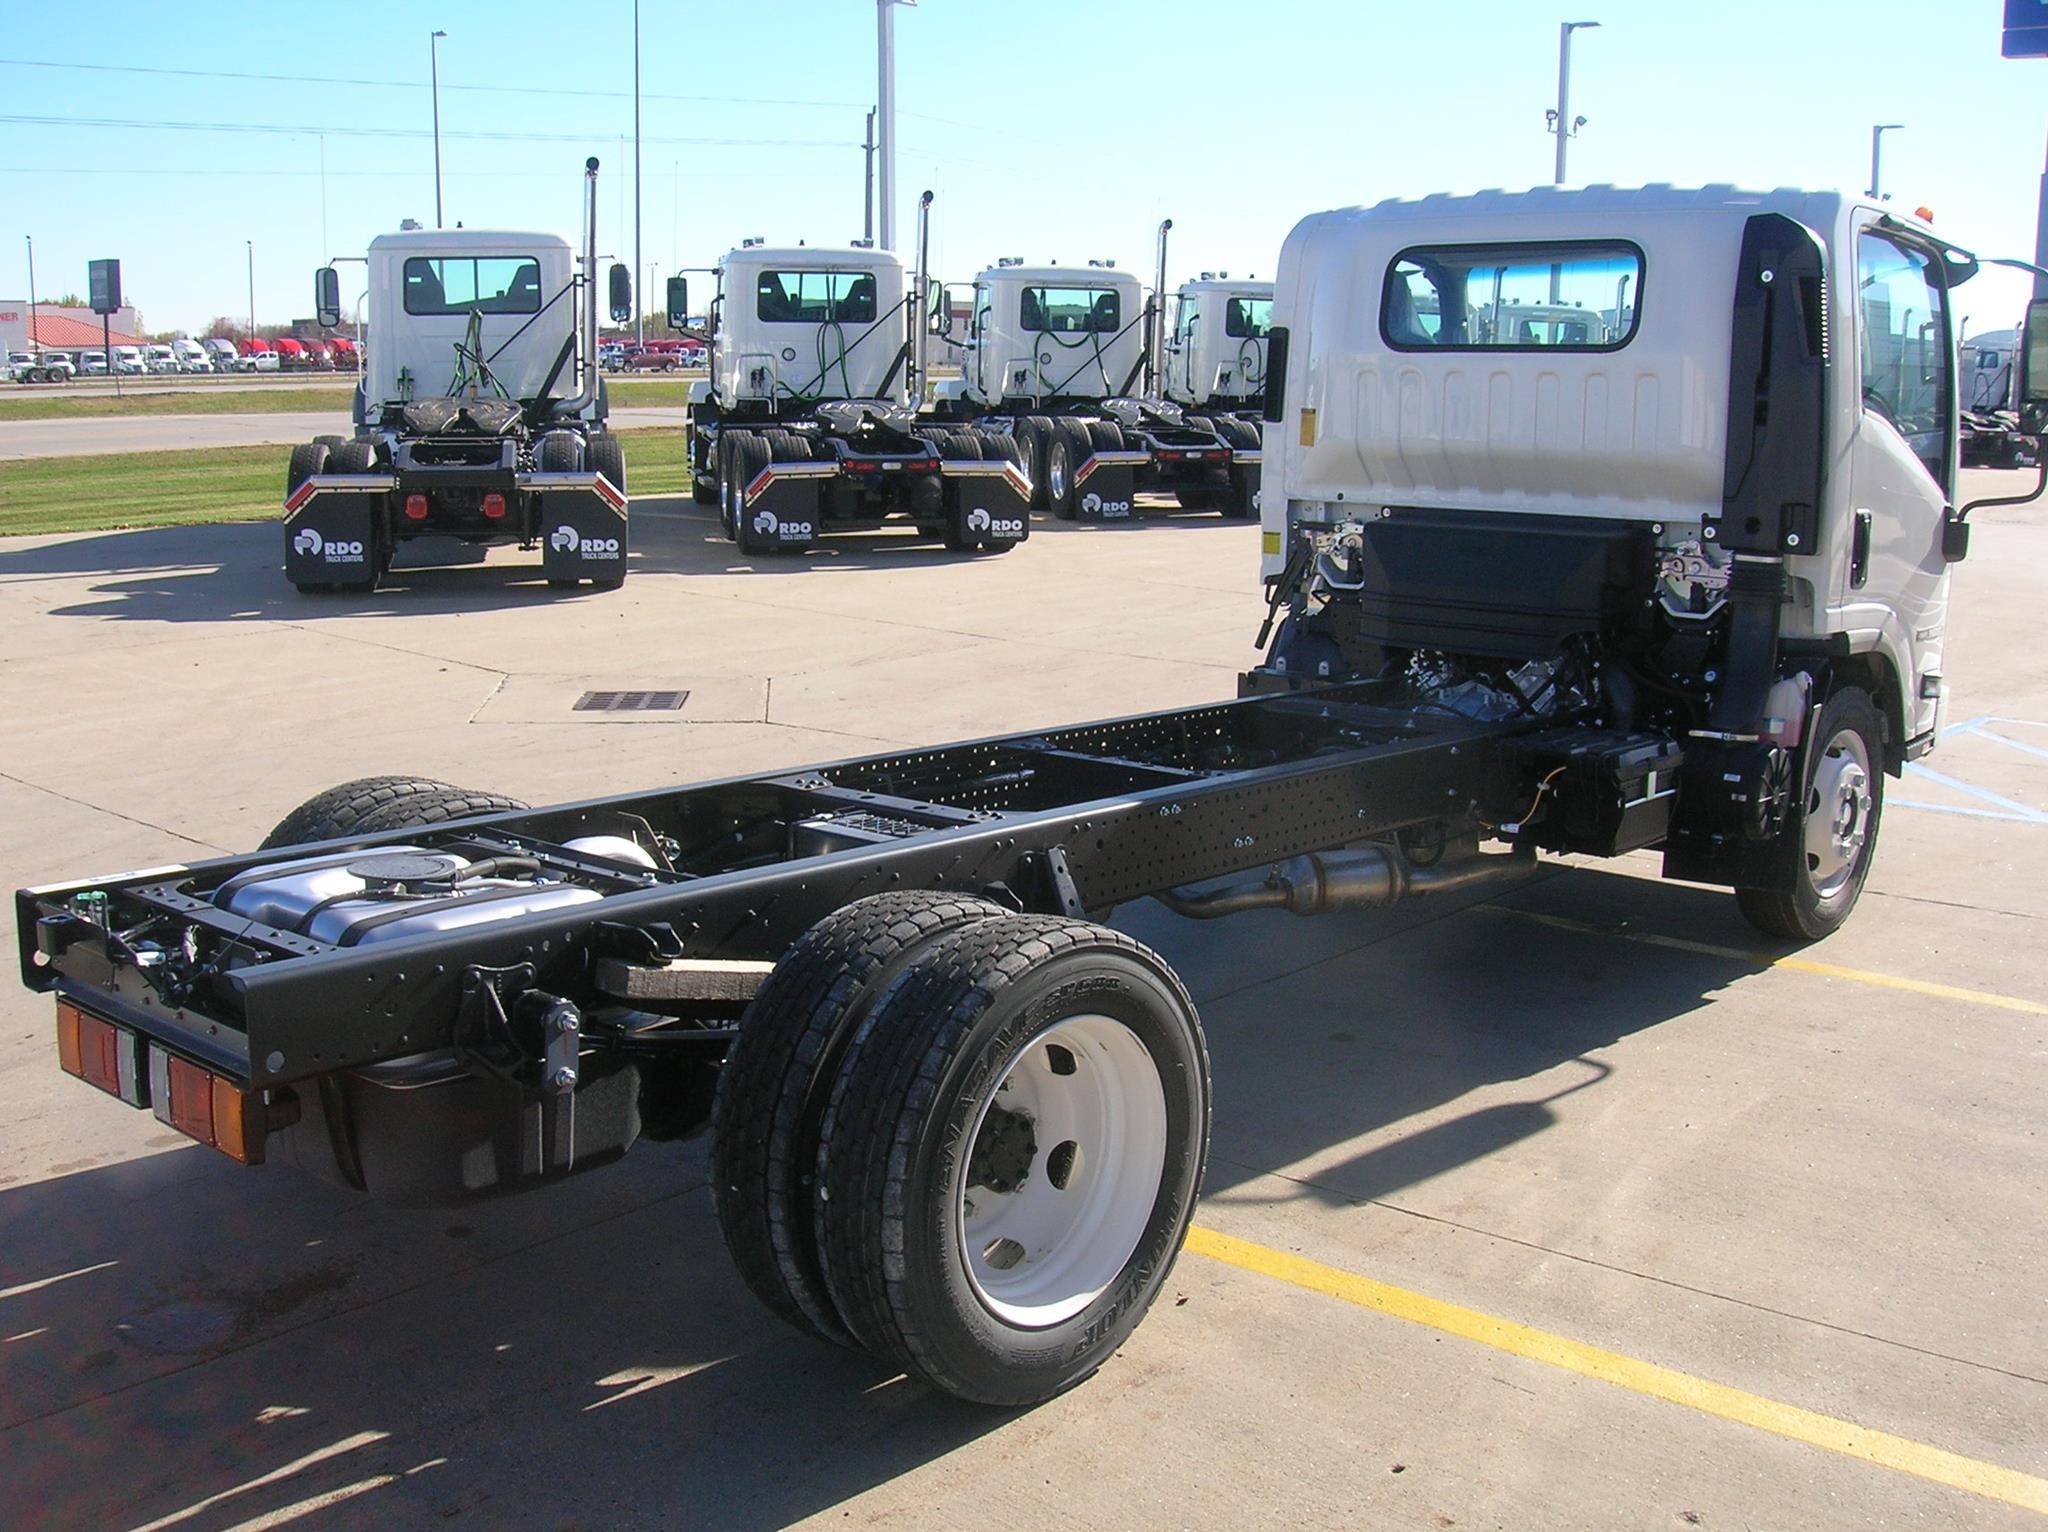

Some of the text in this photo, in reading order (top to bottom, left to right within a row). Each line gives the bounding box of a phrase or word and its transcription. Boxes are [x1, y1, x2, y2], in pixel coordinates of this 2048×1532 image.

[1102, 501, 1129, 512] RDO
[779, 522, 812, 534] RDO
[991, 519, 1023, 531] RDO
[324, 541, 363, 555] RDO
[580, 538, 619, 552] RDO
